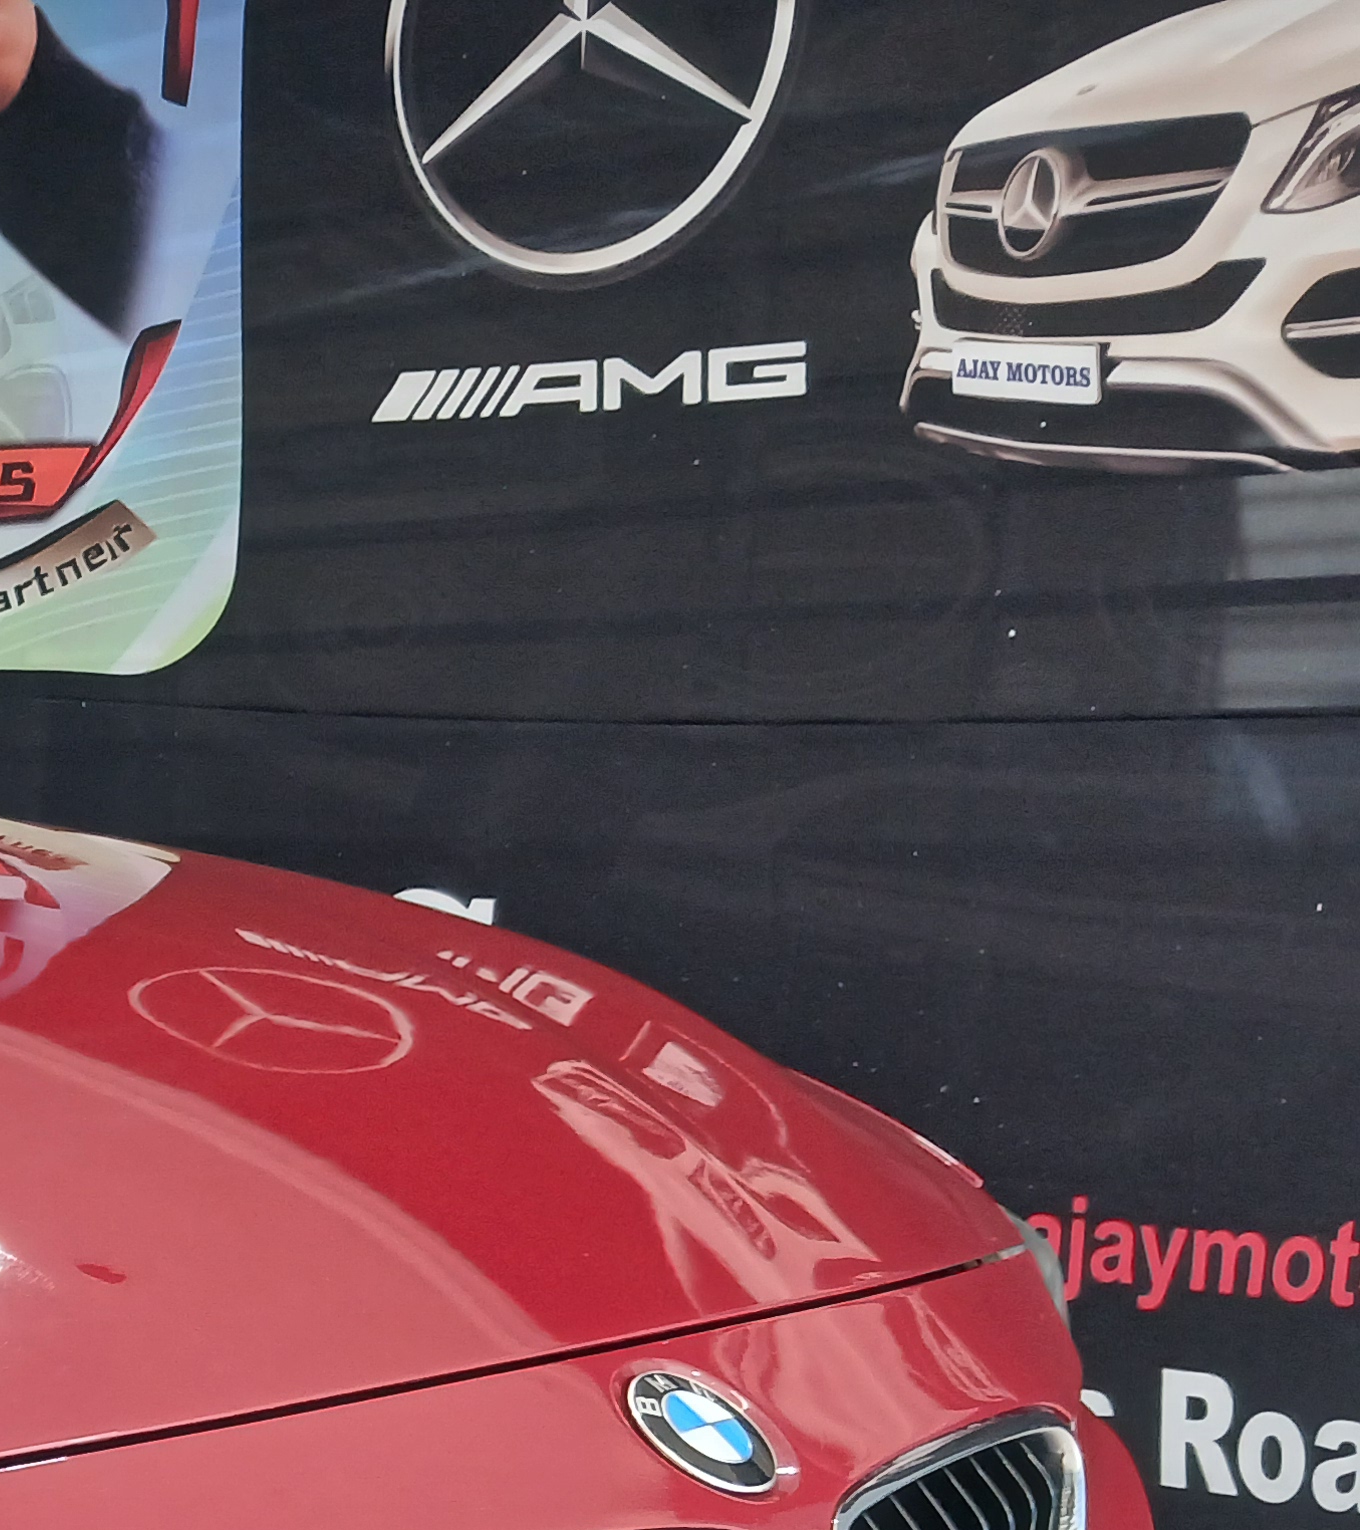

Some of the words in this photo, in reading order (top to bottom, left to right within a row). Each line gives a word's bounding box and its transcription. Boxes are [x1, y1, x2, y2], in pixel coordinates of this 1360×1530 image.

[497, 340, 807, 418] AMG
[956, 357, 1002, 381] AJAY
[1006, 361, 1092, 388] MOTORS
